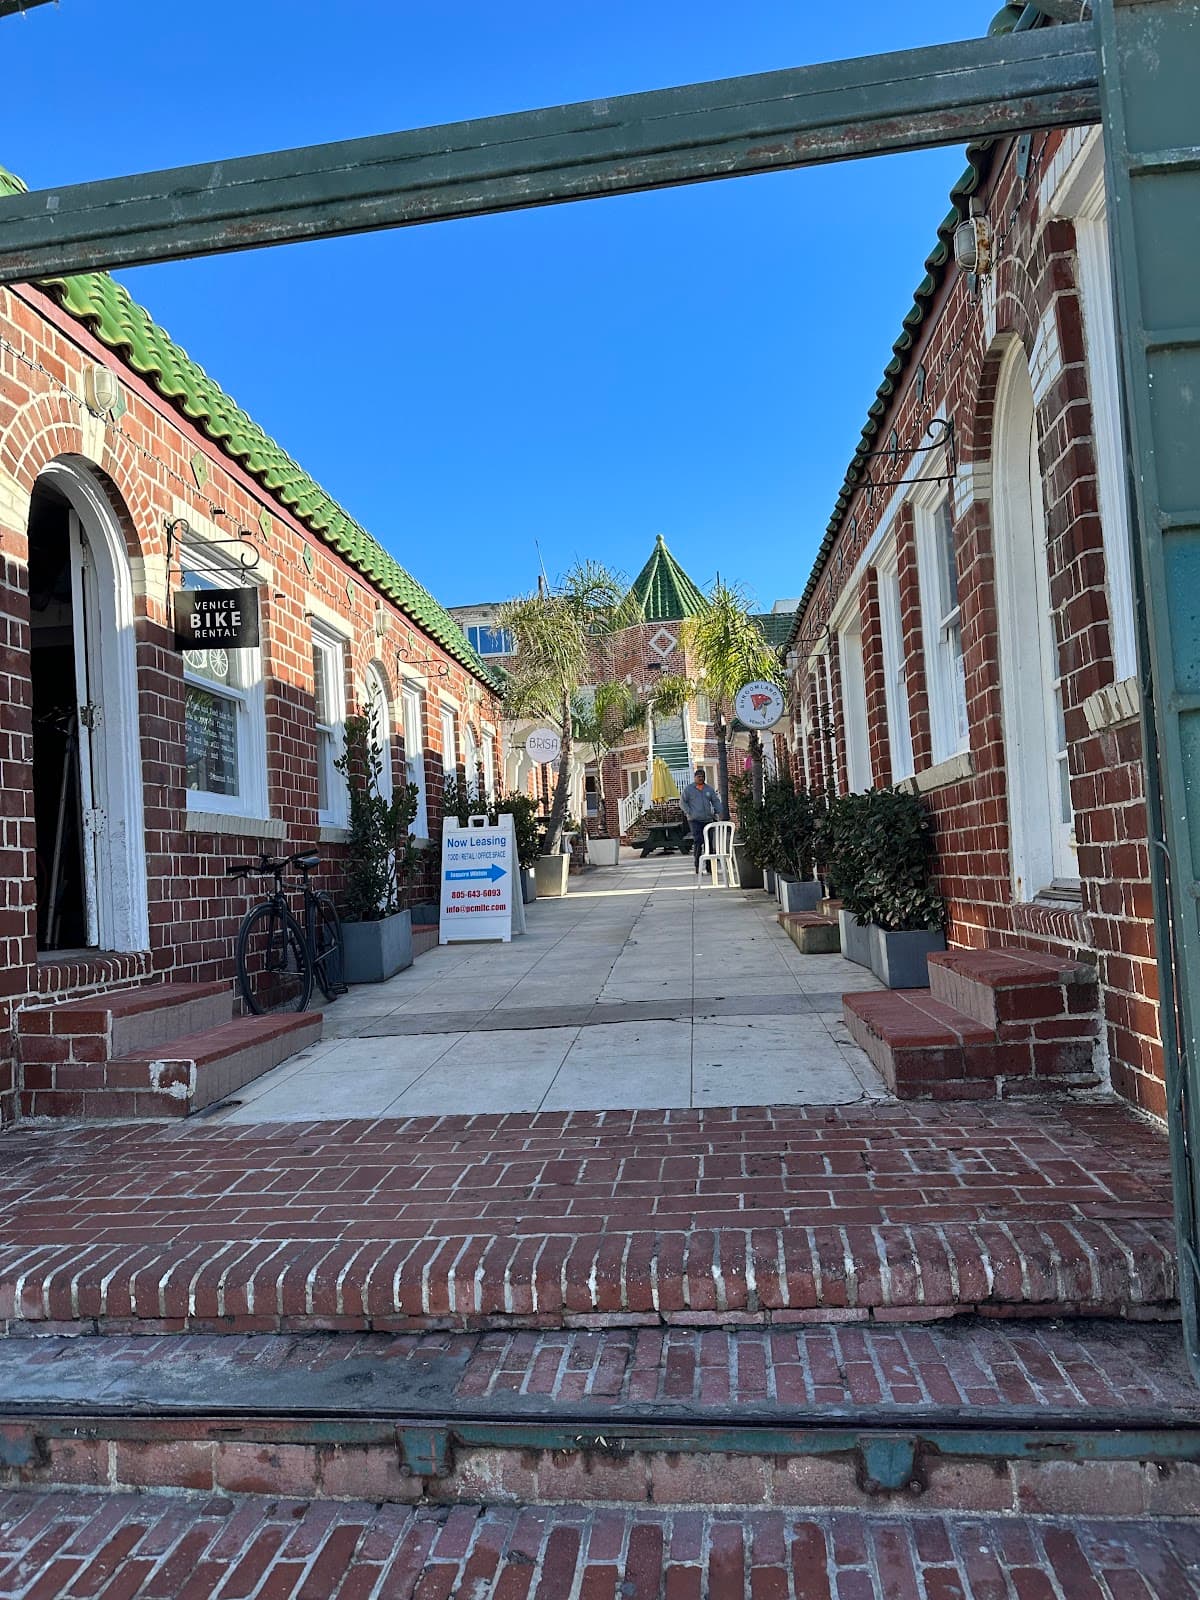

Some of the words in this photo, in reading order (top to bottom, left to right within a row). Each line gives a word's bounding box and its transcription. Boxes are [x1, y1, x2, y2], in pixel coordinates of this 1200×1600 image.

[194, 600, 236, 610] VENICE
[190, 611, 242, 628] BIKE
[194, 628, 238, 638] RENTAL
[529, 737, 558, 750] BRISA
[447, 838, 468, 848] Now
[470, 835, 506, 847] Leasing
[461, 852, 475, 860] RETAIL
[477, 851, 492, 859] OFFICE
[492, 850, 506, 858] SPACE
[451, 888, 501, 899] 805-643-6093
